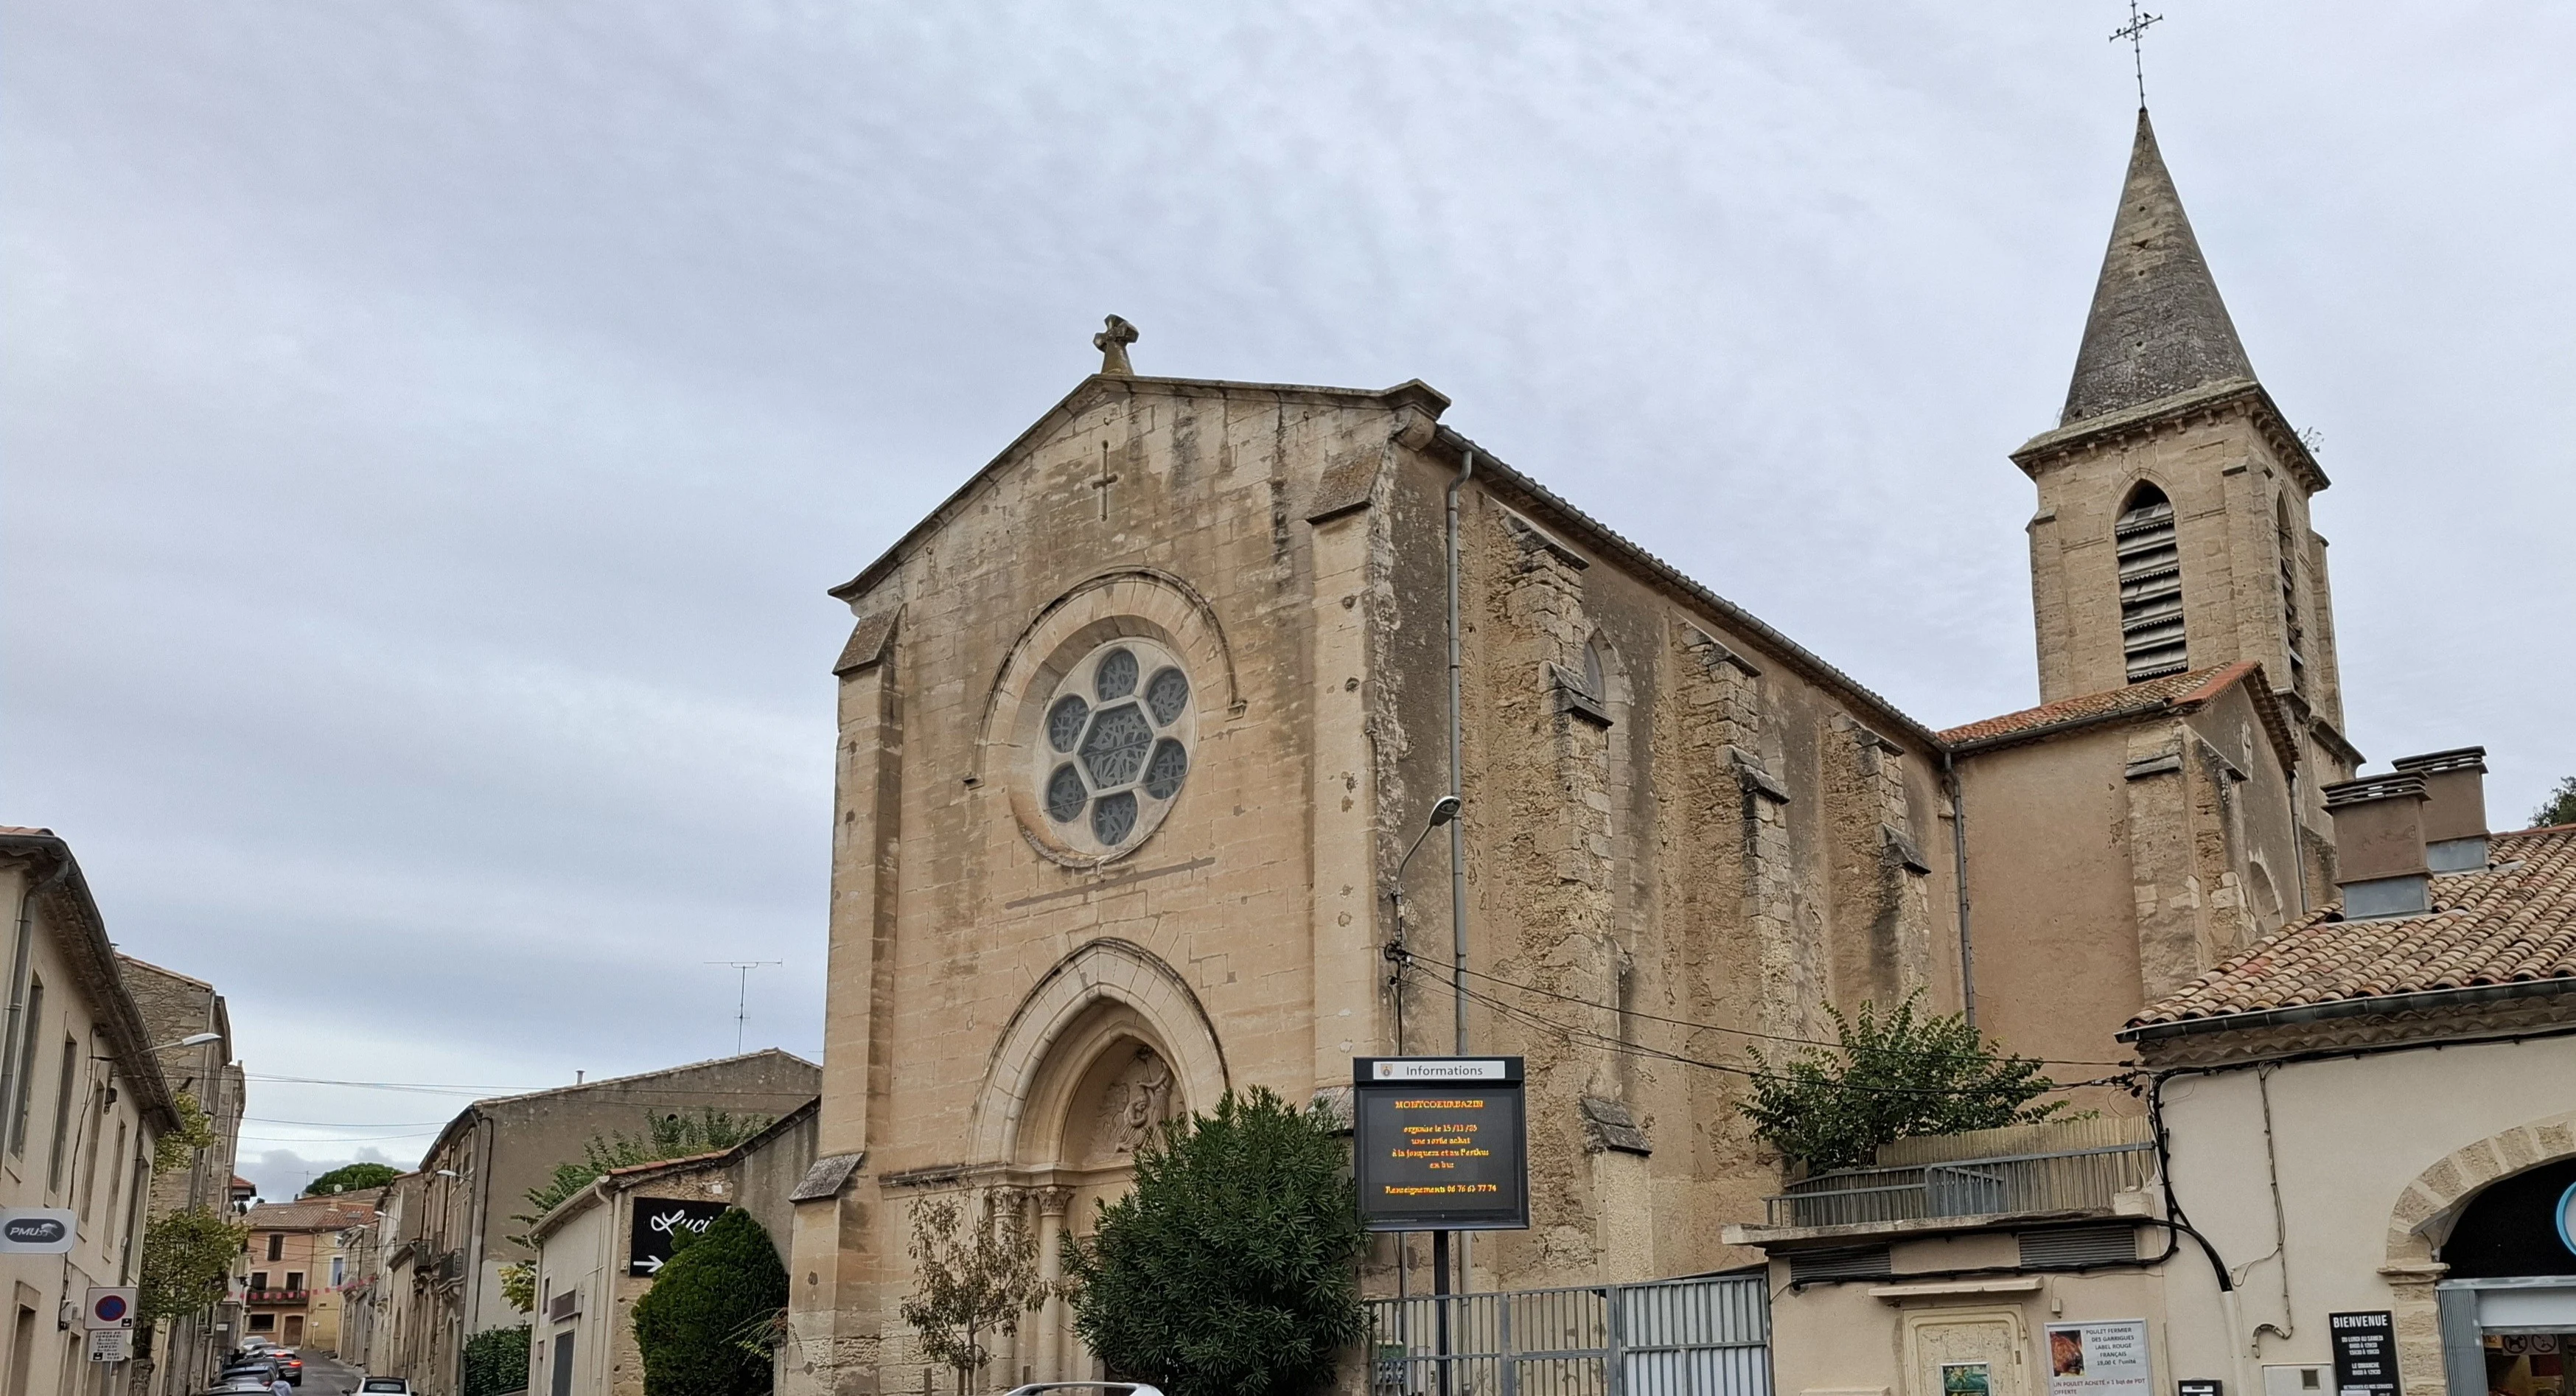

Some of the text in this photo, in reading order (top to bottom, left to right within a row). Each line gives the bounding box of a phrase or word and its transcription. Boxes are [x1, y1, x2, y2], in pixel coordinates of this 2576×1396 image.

[1406, 1065, 1484, 1076] Informations
[1447, 1184, 1456, 1193] 06
[10, 1227, 40, 1236] PMU
[2333, 1315, 2388, 1328] BIENVENUE
